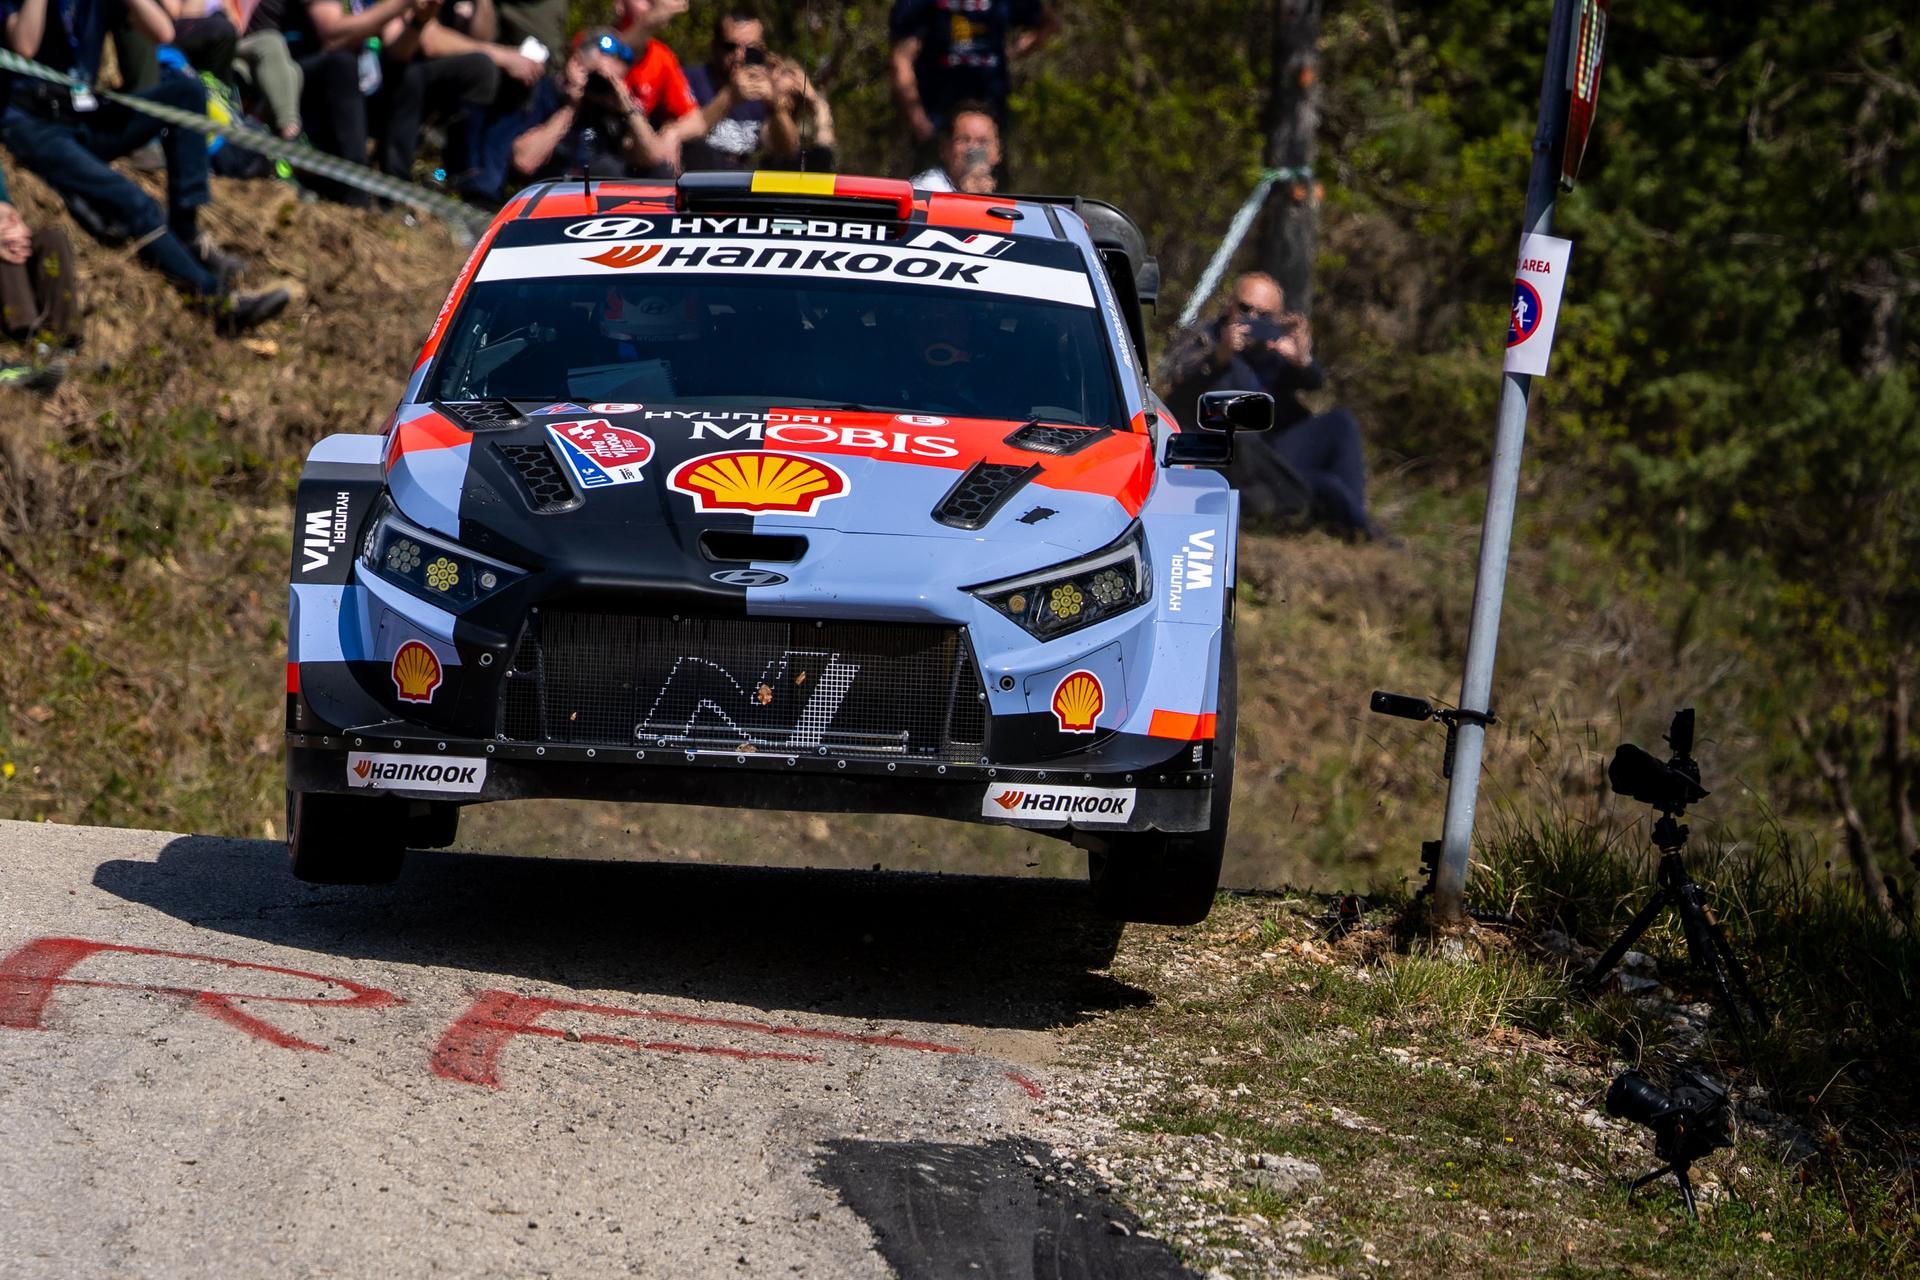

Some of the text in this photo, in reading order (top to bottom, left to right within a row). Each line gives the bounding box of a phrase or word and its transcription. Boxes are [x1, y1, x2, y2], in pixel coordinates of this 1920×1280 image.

[671, 217, 886, 241] HYUNDAI
[1521, 258, 1551, 274] AREA
[645, 411, 832, 424] HYUNDAI
[591, 441, 614, 458] RALLY
[688, 421, 959, 457] MOBIS
[333, 492, 350, 543] HYUNDAI
[1169, 554, 1184, 611] HYUNDAI
